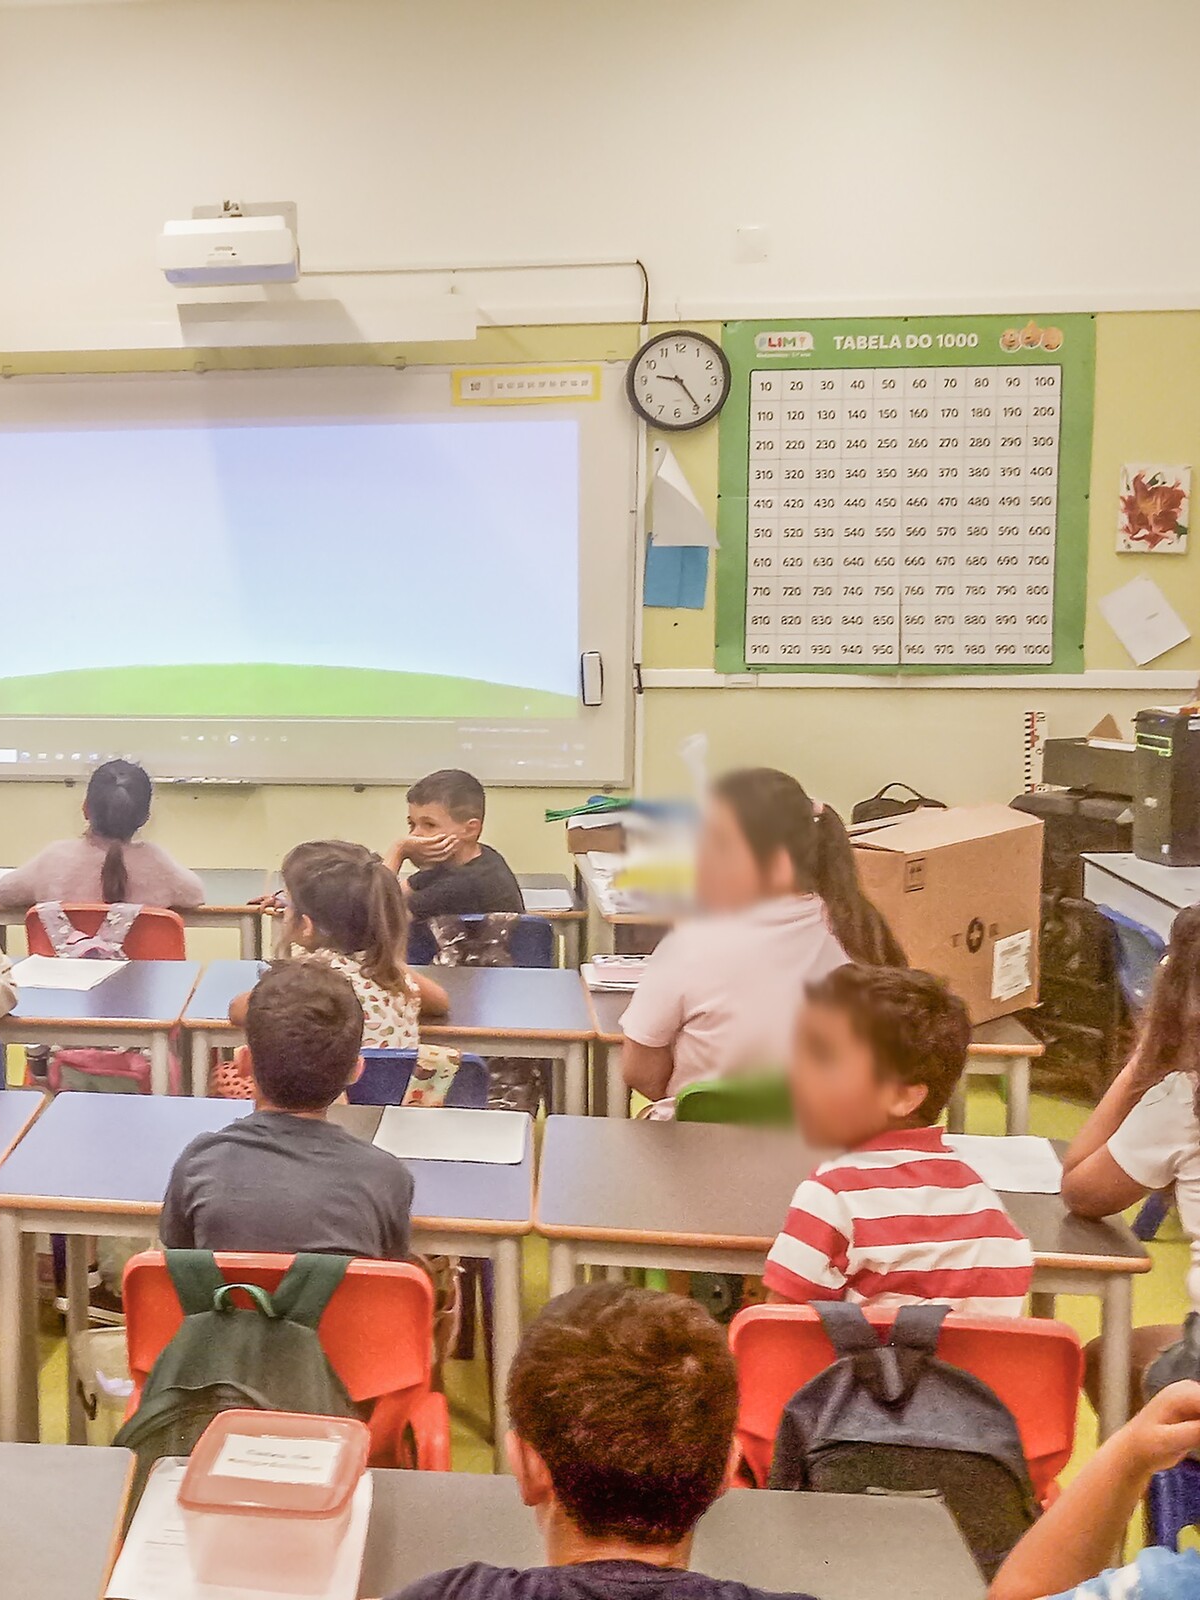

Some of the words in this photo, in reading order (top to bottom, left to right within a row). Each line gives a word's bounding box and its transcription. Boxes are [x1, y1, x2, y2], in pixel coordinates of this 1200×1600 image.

[833, 334, 902, 350] TABELA
[905, 333, 933, 349] DO
[936, 333, 978, 348] 1000
[659, 348, 668, 358] 11
[675, 343, 687, 353] 12
[696, 348, 701, 358] 1
[646, 359, 657, 370] 10
[705, 360, 713, 370] 2
[640, 376, 647, 386] 9
[710, 376, 718, 386] 3
[759, 381, 772, 392] 10
[789, 380, 803, 392] 20
[820, 380, 834, 391] 30
[849, 379, 865, 390] 40
[881, 378, 896, 390] 50
[911, 378, 927, 389] 60
[943, 377, 957, 389] 70
[974, 377, 989, 388] 80
[1005, 376, 1020, 388] 90
[1034, 376, 1055, 387] 100
[646, 394, 653, 403] 8
[704, 394, 711, 403] 4
[657, 405, 665, 415] 7
[673, 408, 681, 418] 6
[757, 410, 773, 422] 110
[786, 410, 804, 421] 120
[816, 409, 835, 421] 130
[847, 409, 867, 420] 140
[877, 408, 897, 420] 150
[909, 408, 928, 419] 160
[940, 407, 959, 419] 170
[970, 407, 991, 418] 180
[1002, 406, 1022, 418] 190
[1032, 406, 1054, 417] 200
[755, 440, 774, 451] 210
[784, 439, 805, 450] 220
[815, 439, 836, 450] 230
[845, 438, 867, 450] 240
[876, 438, 898, 449] 250
[907, 437, 928, 449] 260
[938, 437, 958, 448] 270
[968, 437, 990, 448] 280
[1000, 436, 1022, 448] 290
[1032, 435, 1053, 447] 300
[754, 469, 773, 480] 310
[783, 469, 804, 480] 320
[815, 468, 835, 480] 330
[844, 468, 867, 479] 340
[875, 467, 897, 479] 350
[906, 467, 928, 479] 360
[938, 467, 958, 478] 370
[967, 466, 990, 478] 380
[999, 466, 1021, 478] 390
[1029, 466, 1053, 477] 400
[753, 498, 773, 509] 410
[782, 498, 804, 509] 420
[813, 497, 835, 509] 430
[843, 497, 866, 508] 440
[874, 497, 897, 508] 450
[905, 496, 928, 508] 460
[936, 496, 958, 508] 470
[966, 496, 989, 507] 480
[997, 495, 1020, 507] 490
[1029, 495, 1052, 507] 500
[753, 527, 772, 539] 510
[783, 527, 803, 539] 520
[813, 527, 834, 538] 530
[843, 527, 865, 538] 540
[874, 526, 896, 538] 550
[905, 526, 926, 537] 560
[936, 526, 956, 537] 570
[966, 525, 988, 537] 580
[997, 525, 1019, 537] 590
[1028, 525, 1051, 536] 600
[752, 557, 772, 568] 610
[782, 556, 803, 568] 620
[812, 556, 833, 567] 630
[842, 556, 864, 567] 640
[873, 556, 895, 567] 650
[904, 555, 925, 567] 660
[935, 555, 955, 567] 670
[965, 555, 987, 567] 680
[996, 555, 1018, 566] 690
[1027, 555, 1049, 566] 700
[752, 586, 771, 597] 710
[782, 586, 801, 597] 720
[812, 586, 832, 597] 730
[842, 585, 863, 597] 740
[874, 585, 894, 597] 750
[904, 585, 924, 596] 760
[934, 585, 955, 596] 770
[965, 585, 986, 596] 780
[996, 585, 1017, 596] 790
[1025, 584, 1049, 596] 800
[750, 615, 770, 626] 810
[780, 615, 801, 626] 820
[810, 615, 832, 626] 830
[840, 615, 863, 626] 840
[872, 614, 894, 626] 850
[904, 614, 925, 626] 860
[934, 614, 954, 626] 870
[963, 614, 986, 626] 880
[995, 614, 1017, 626] 890
[1025, 614, 1048, 626] 900
[750, 644, 770, 655] 910
[779, 644, 801, 655] 920
[810, 644, 831, 655] 930
[840, 644, 863, 655] 940
[871, 644, 893, 655] 950
[903, 644, 925, 655] 960
[933, 644, 954, 655] 970
[963, 644, 986, 655] 980
[994, 644, 1016, 655] 990
[1022, 644, 1052, 655] 1000
